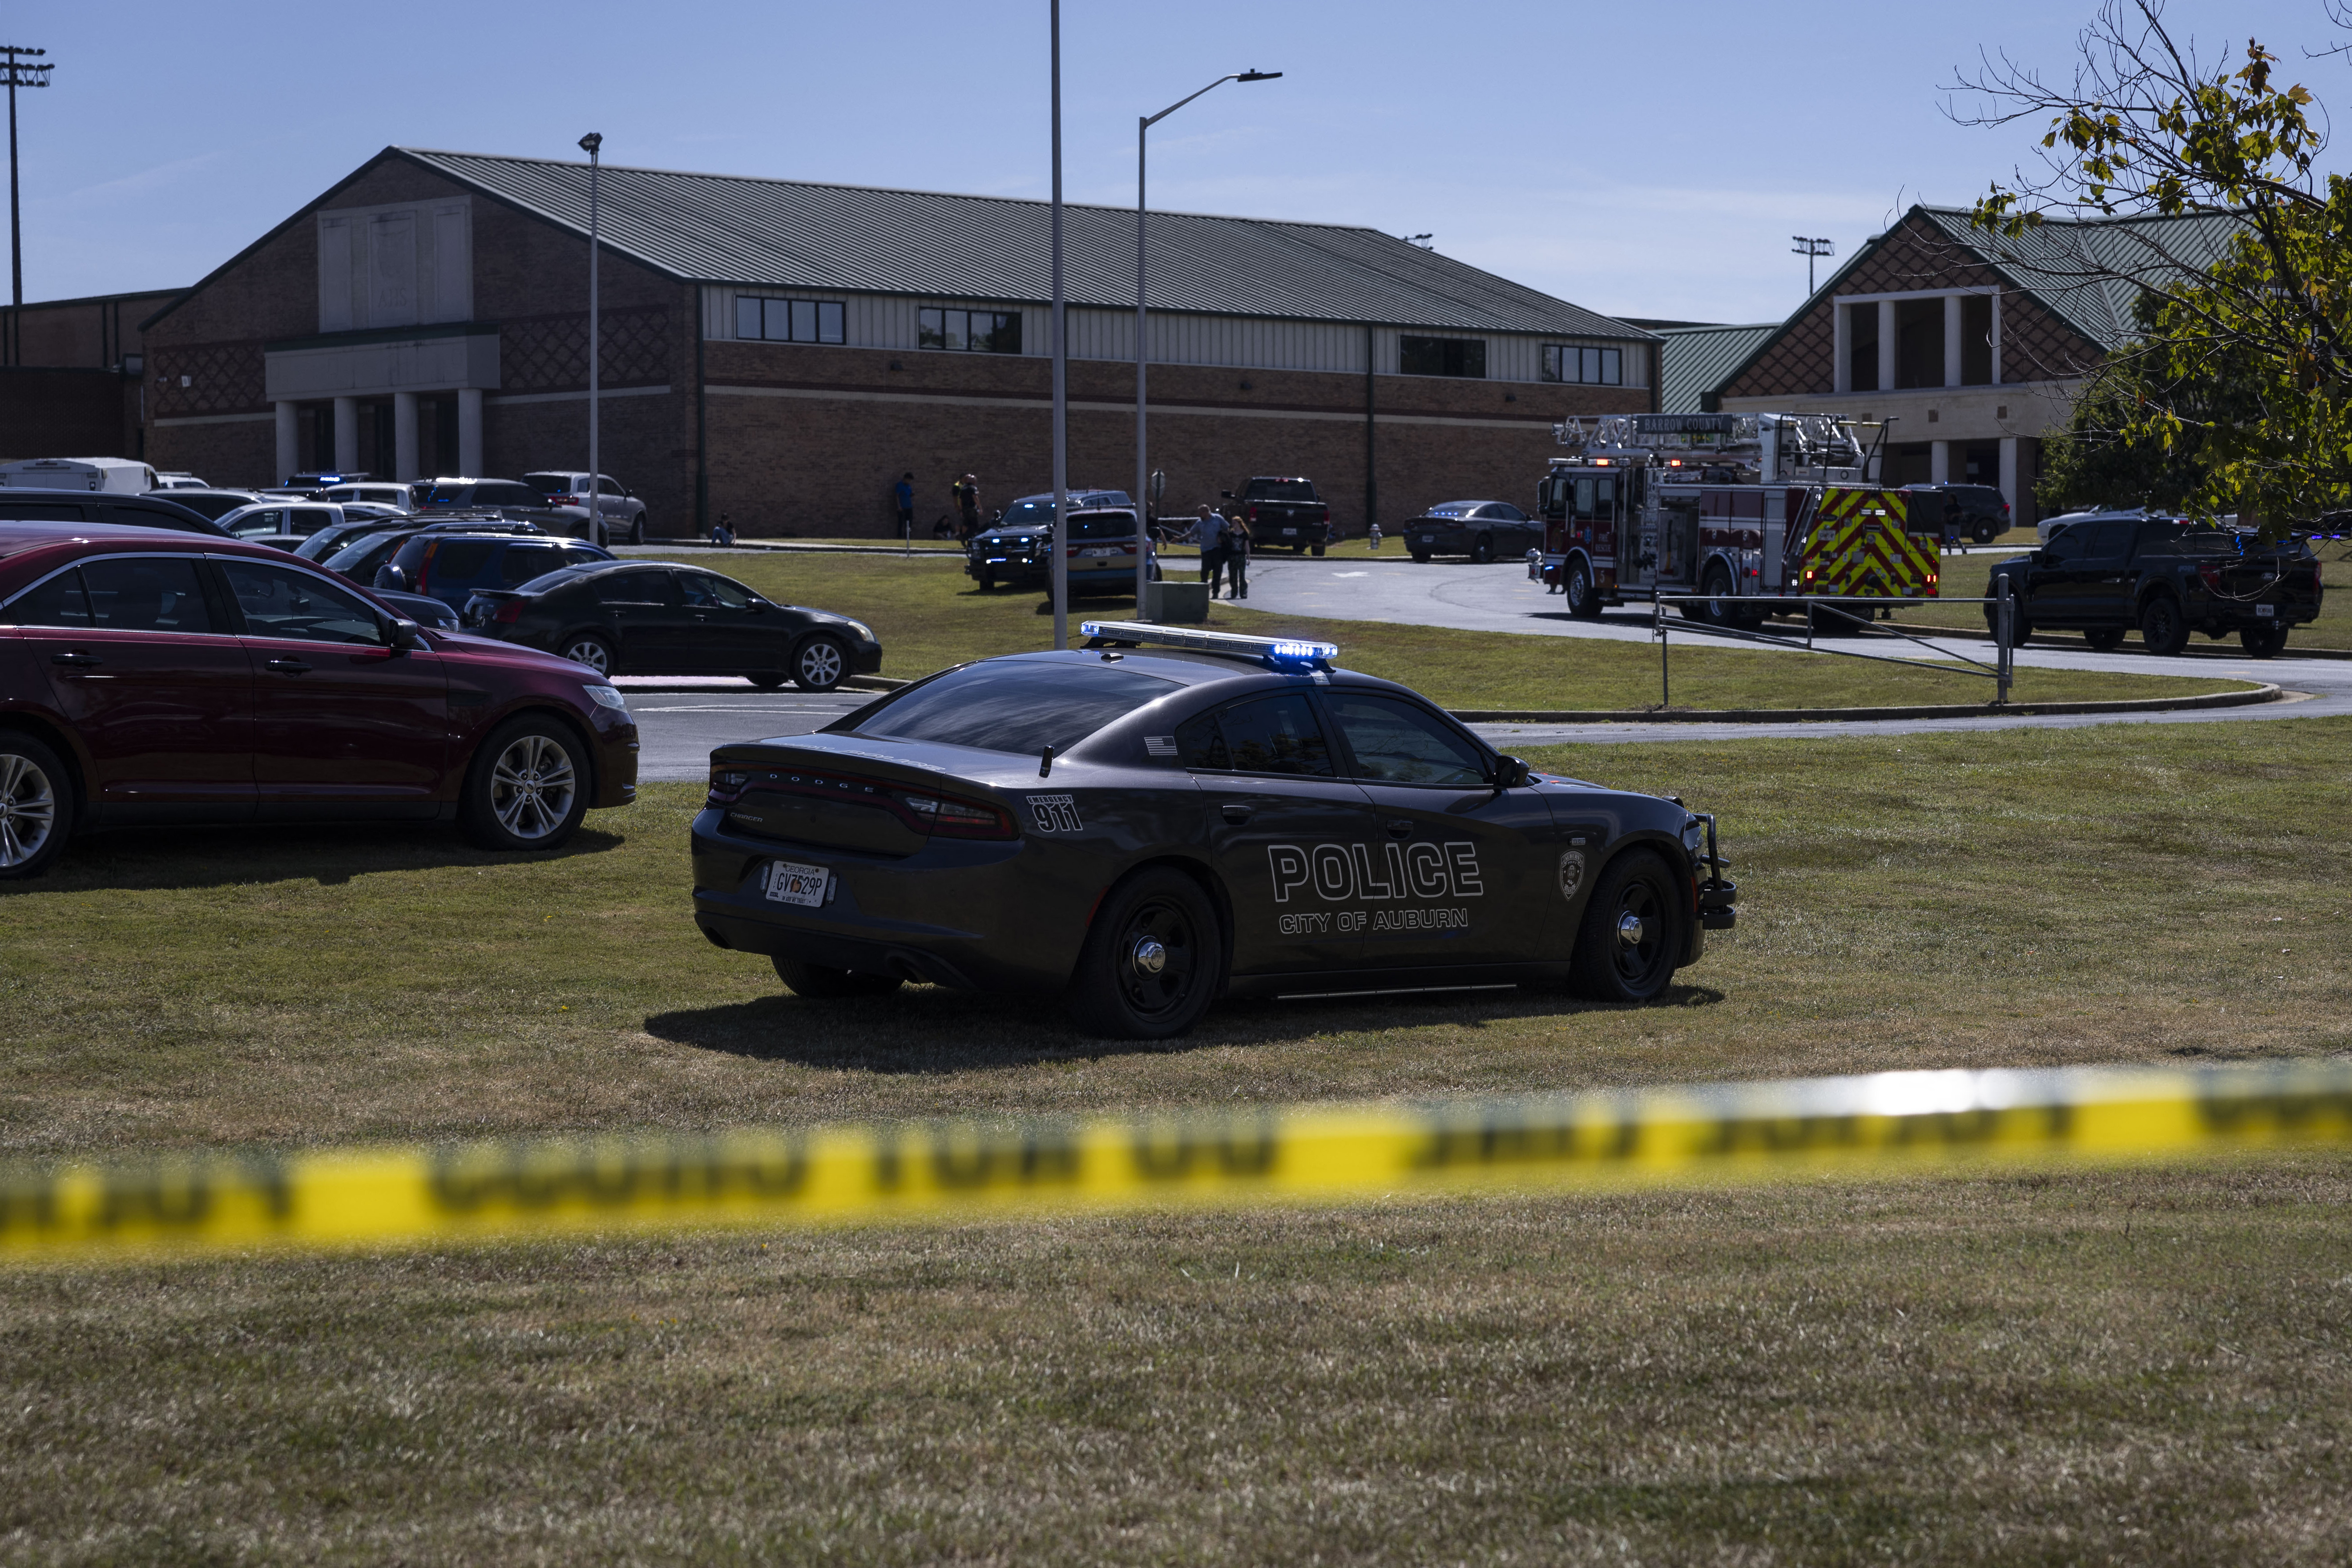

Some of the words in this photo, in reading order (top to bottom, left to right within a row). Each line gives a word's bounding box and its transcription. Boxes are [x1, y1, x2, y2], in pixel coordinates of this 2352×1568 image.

[1644, 416, 1683, 431] BARROW
[1686, 415, 1724, 430] COUNTY
[1599, 570, 1605, 584] 5
[769, 774, 875, 793] DODGE
[1027, 795, 1073, 804] EMERGENCY
[730, 812, 764, 822] CHARGER
[1032, 803, 1083, 832] 911
[785, 865, 815, 875] GEORGIA
[1267, 842, 1484, 903] POLICE
[777, 873, 823, 896] GV7529P
[1279, 912, 1331, 934] CITY
[1337, 911, 1367, 932] OF
[1373, 908, 1468, 930] AUBURN
